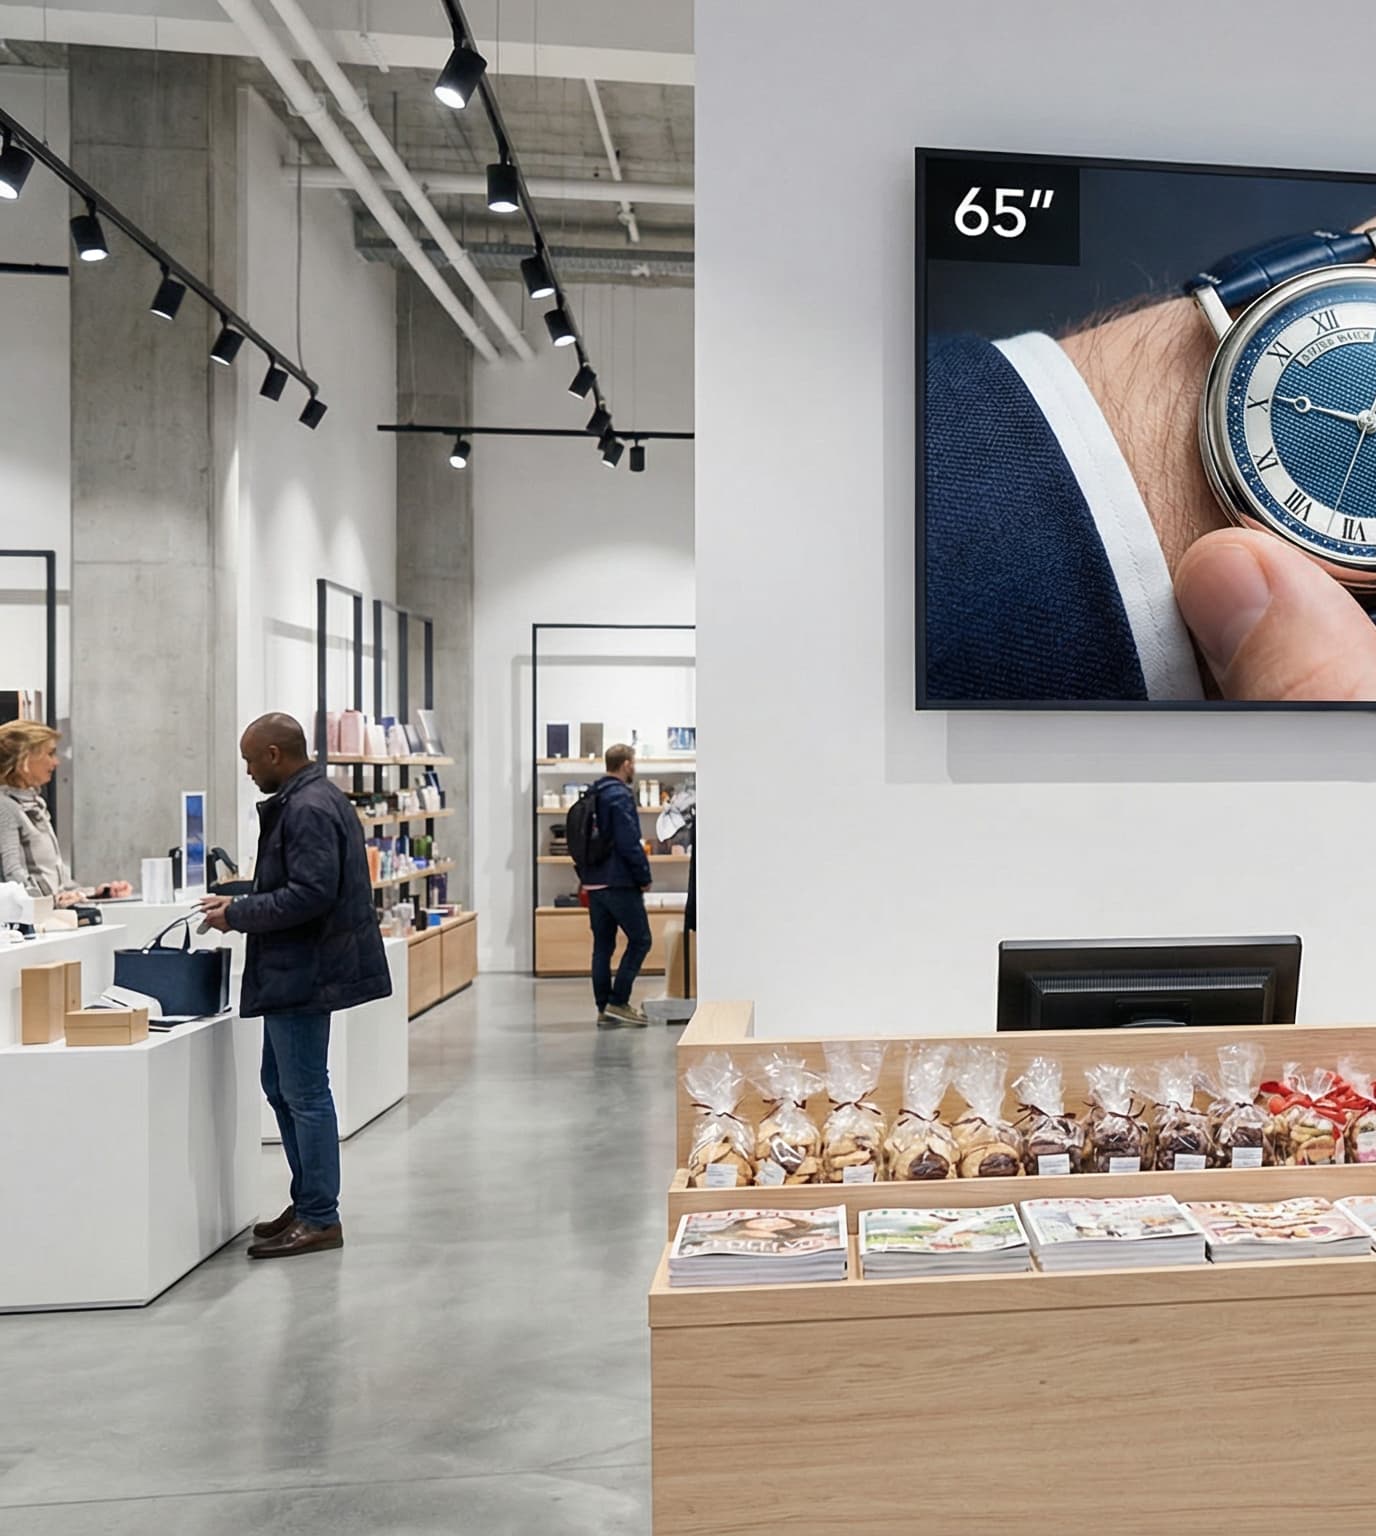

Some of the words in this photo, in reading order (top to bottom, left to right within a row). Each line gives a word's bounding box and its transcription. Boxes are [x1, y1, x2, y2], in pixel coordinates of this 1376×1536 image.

[953, 186, 1055, 238] 65"
[1311, 309, 1340, 336] XII
[1266, 340, 1293, 367] XI
[1246, 395, 1270, 413] X
[1252, 447, 1279, 472] IX
[1283, 488, 1313, 522] VIII
[1342, 517, 1366, 542] VII
